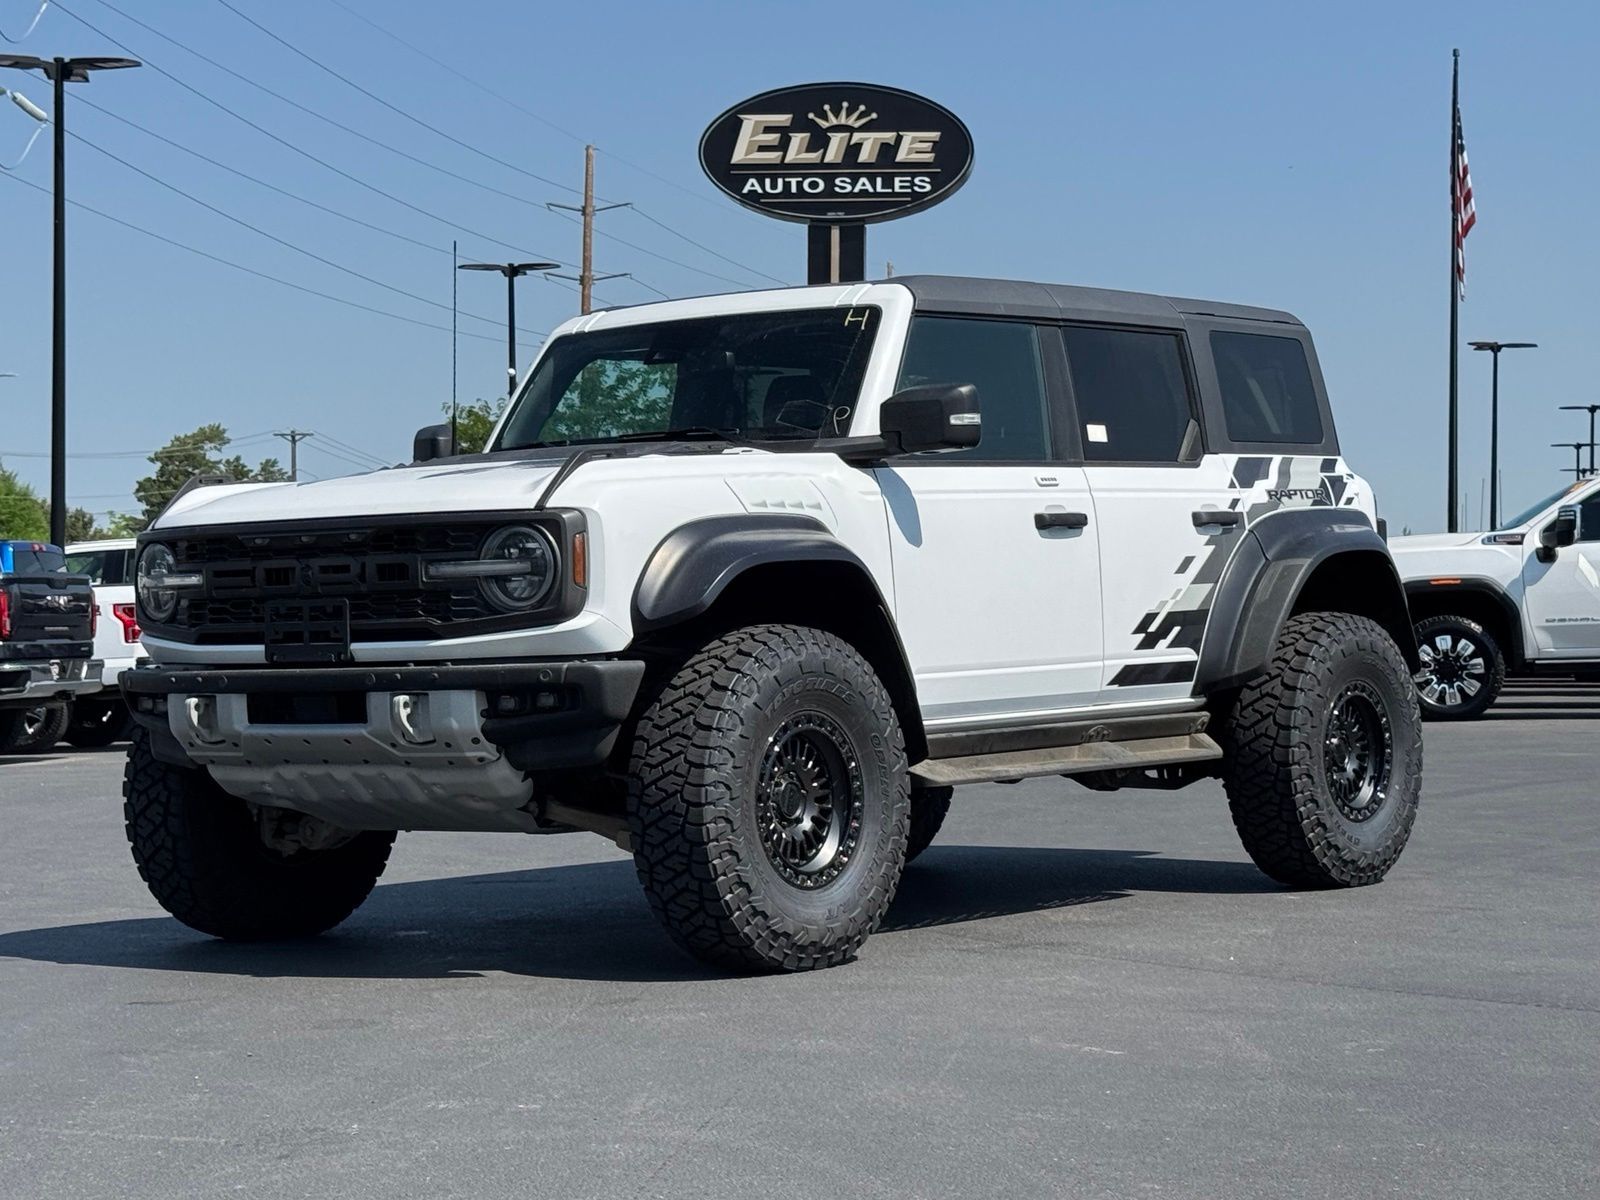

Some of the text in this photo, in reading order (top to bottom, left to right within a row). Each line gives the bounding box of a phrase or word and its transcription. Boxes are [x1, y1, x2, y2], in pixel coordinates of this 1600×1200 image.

[730, 113, 942, 165] ELITE
[741, 176, 932, 194] AUTO SALES
[1265, 488, 1331, 505] RAPTOR
